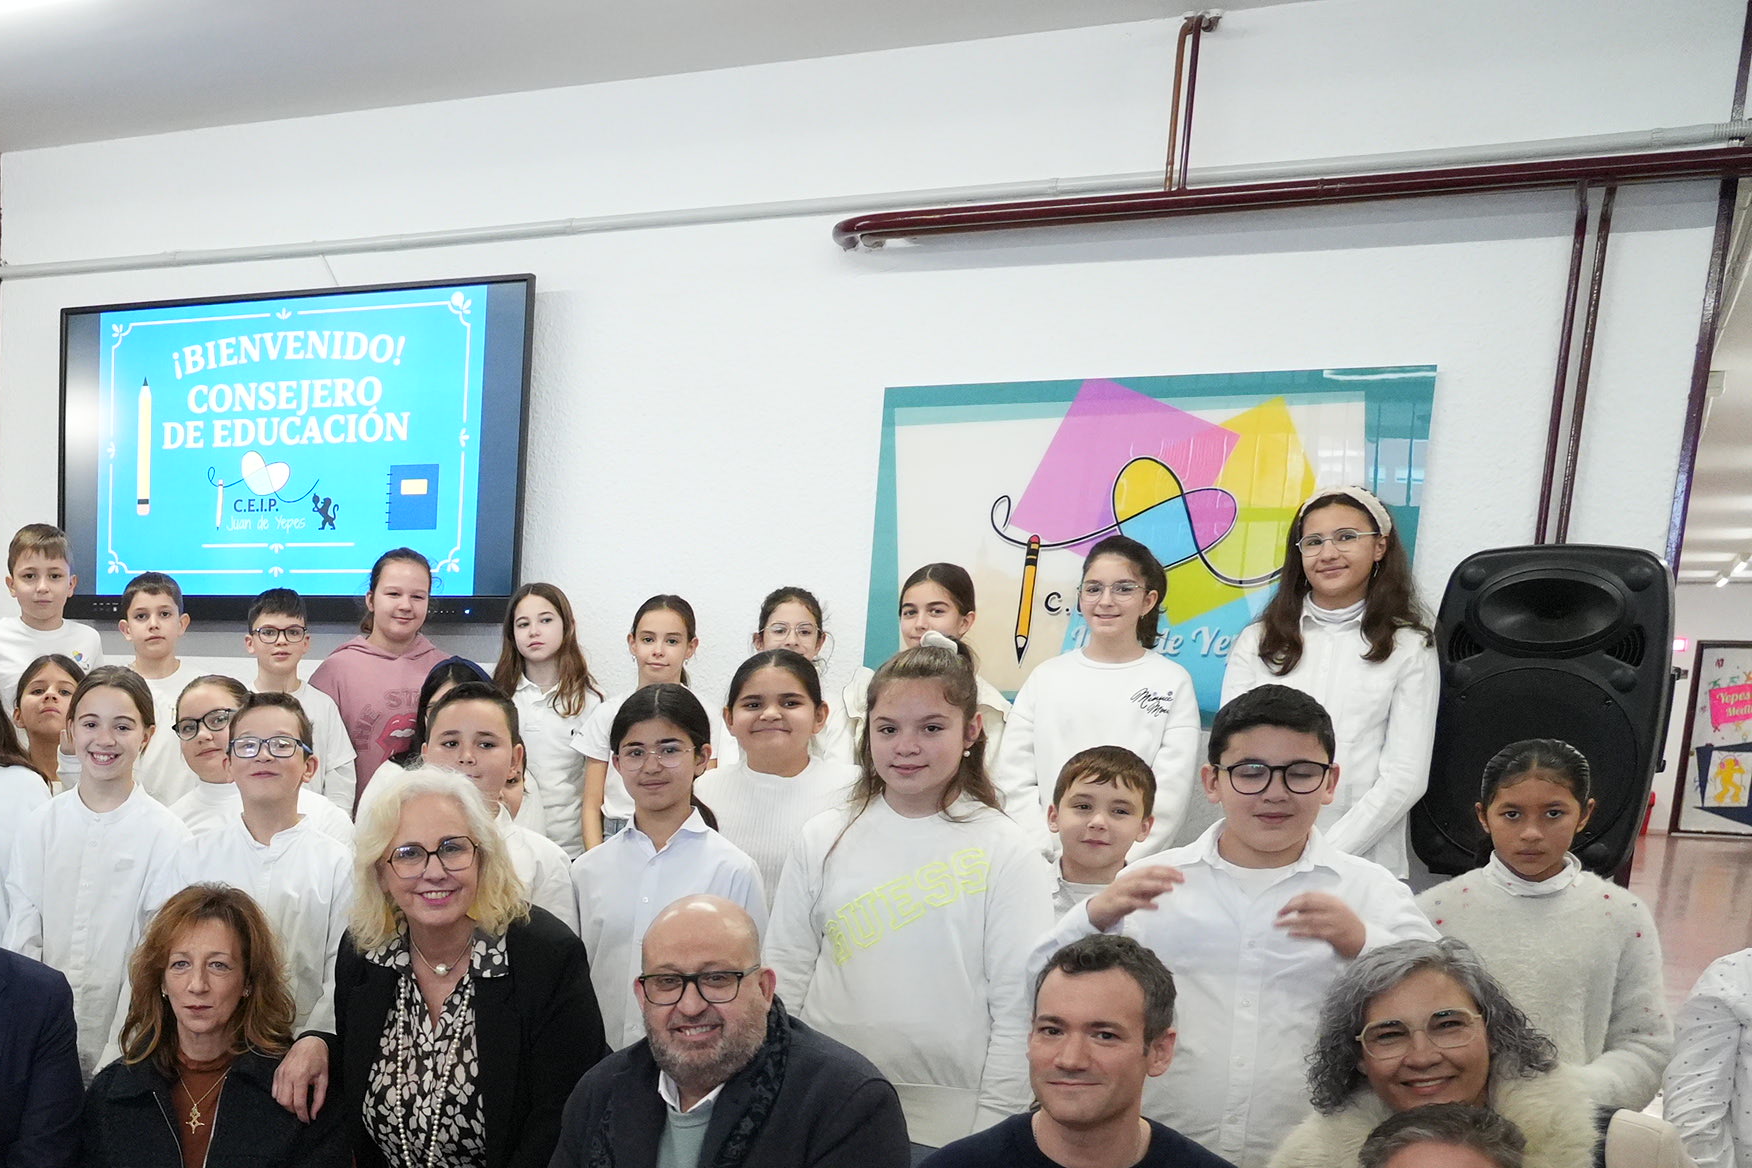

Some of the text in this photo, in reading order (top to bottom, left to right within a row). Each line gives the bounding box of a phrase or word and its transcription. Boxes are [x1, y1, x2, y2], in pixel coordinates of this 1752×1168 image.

[172, 330, 406, 380] ¡BIENVENIDO!
[187, 376, 383, 416] CONSEJERO
[162, 406, 411, 449] DE EDUCACIÓN
[233, 498, 279, 513] C.E.I.P.
[226, 515, 306, 534] Juan de Yepes
[1191, 626, 1239, 657] Ye
